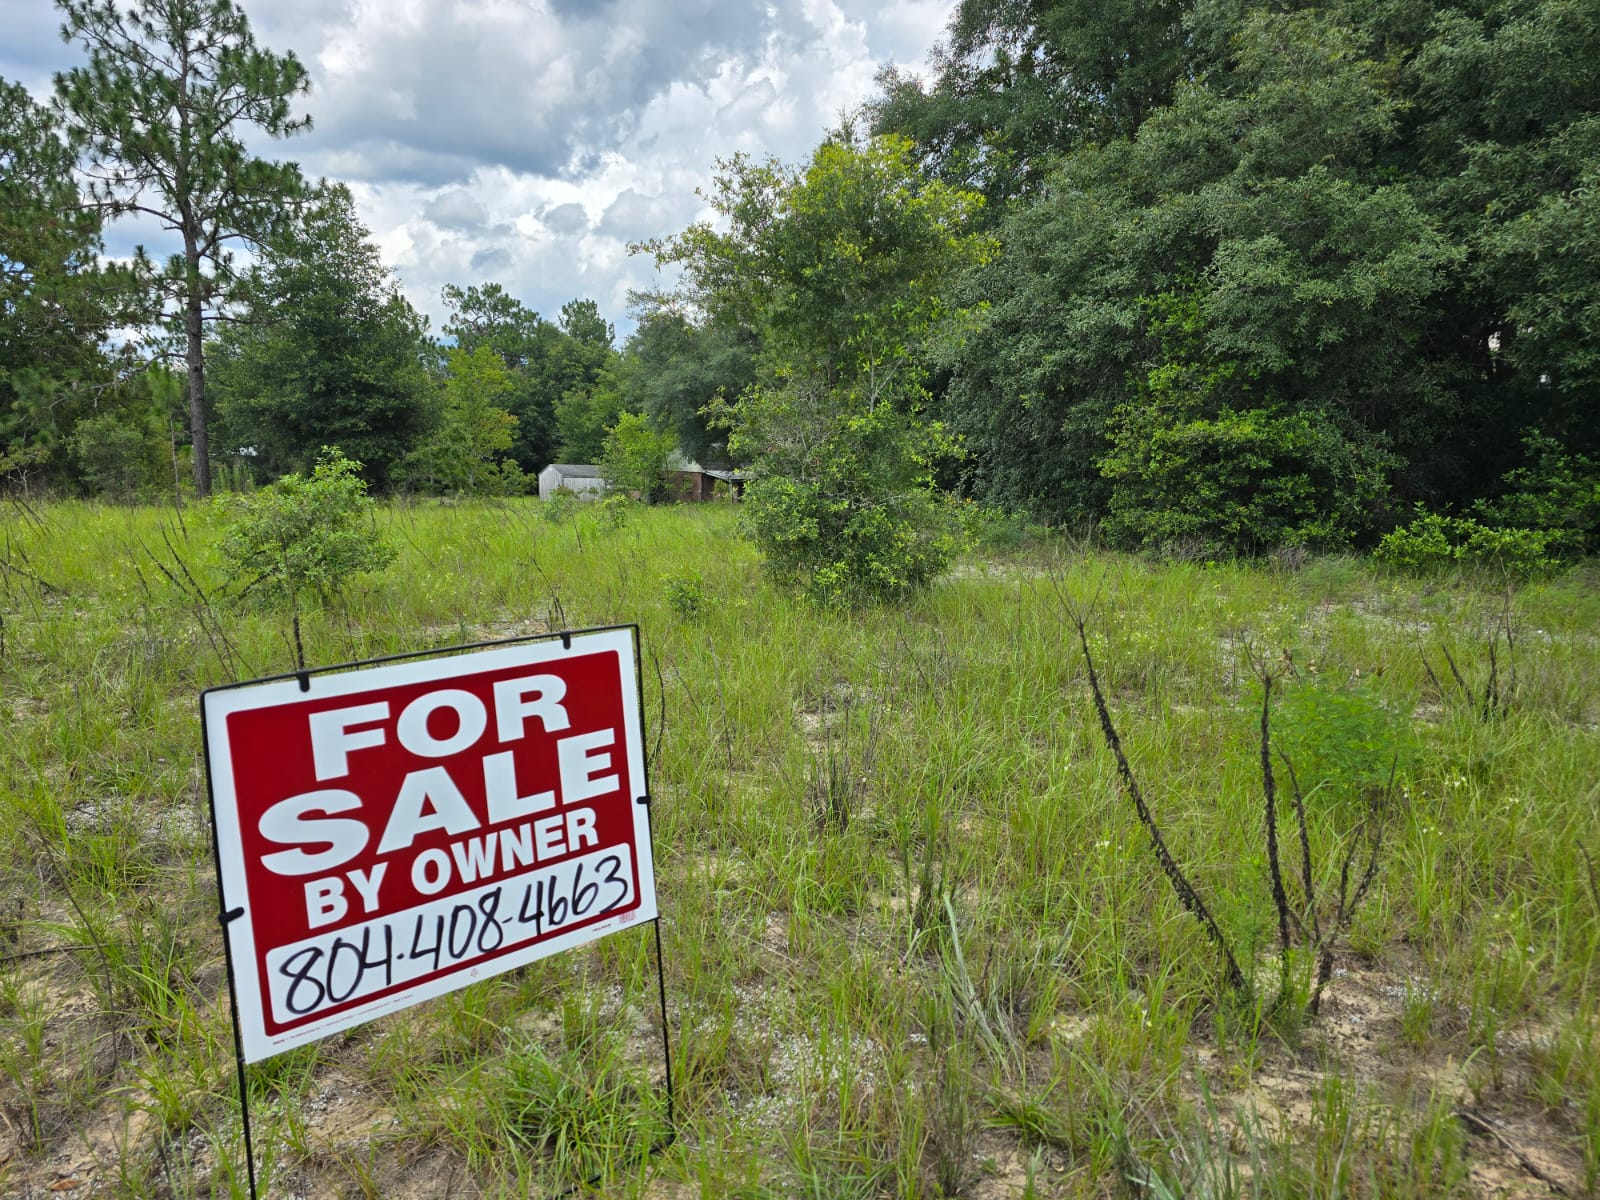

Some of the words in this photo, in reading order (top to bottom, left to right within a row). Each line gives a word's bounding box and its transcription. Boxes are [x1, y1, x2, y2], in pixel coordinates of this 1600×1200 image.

[309, 674, 572, 782] FOR
[258, 728, 620, 876] SALE
[304, 862, 389, 930] BY
[411, 807, 599, 896] OWNER
